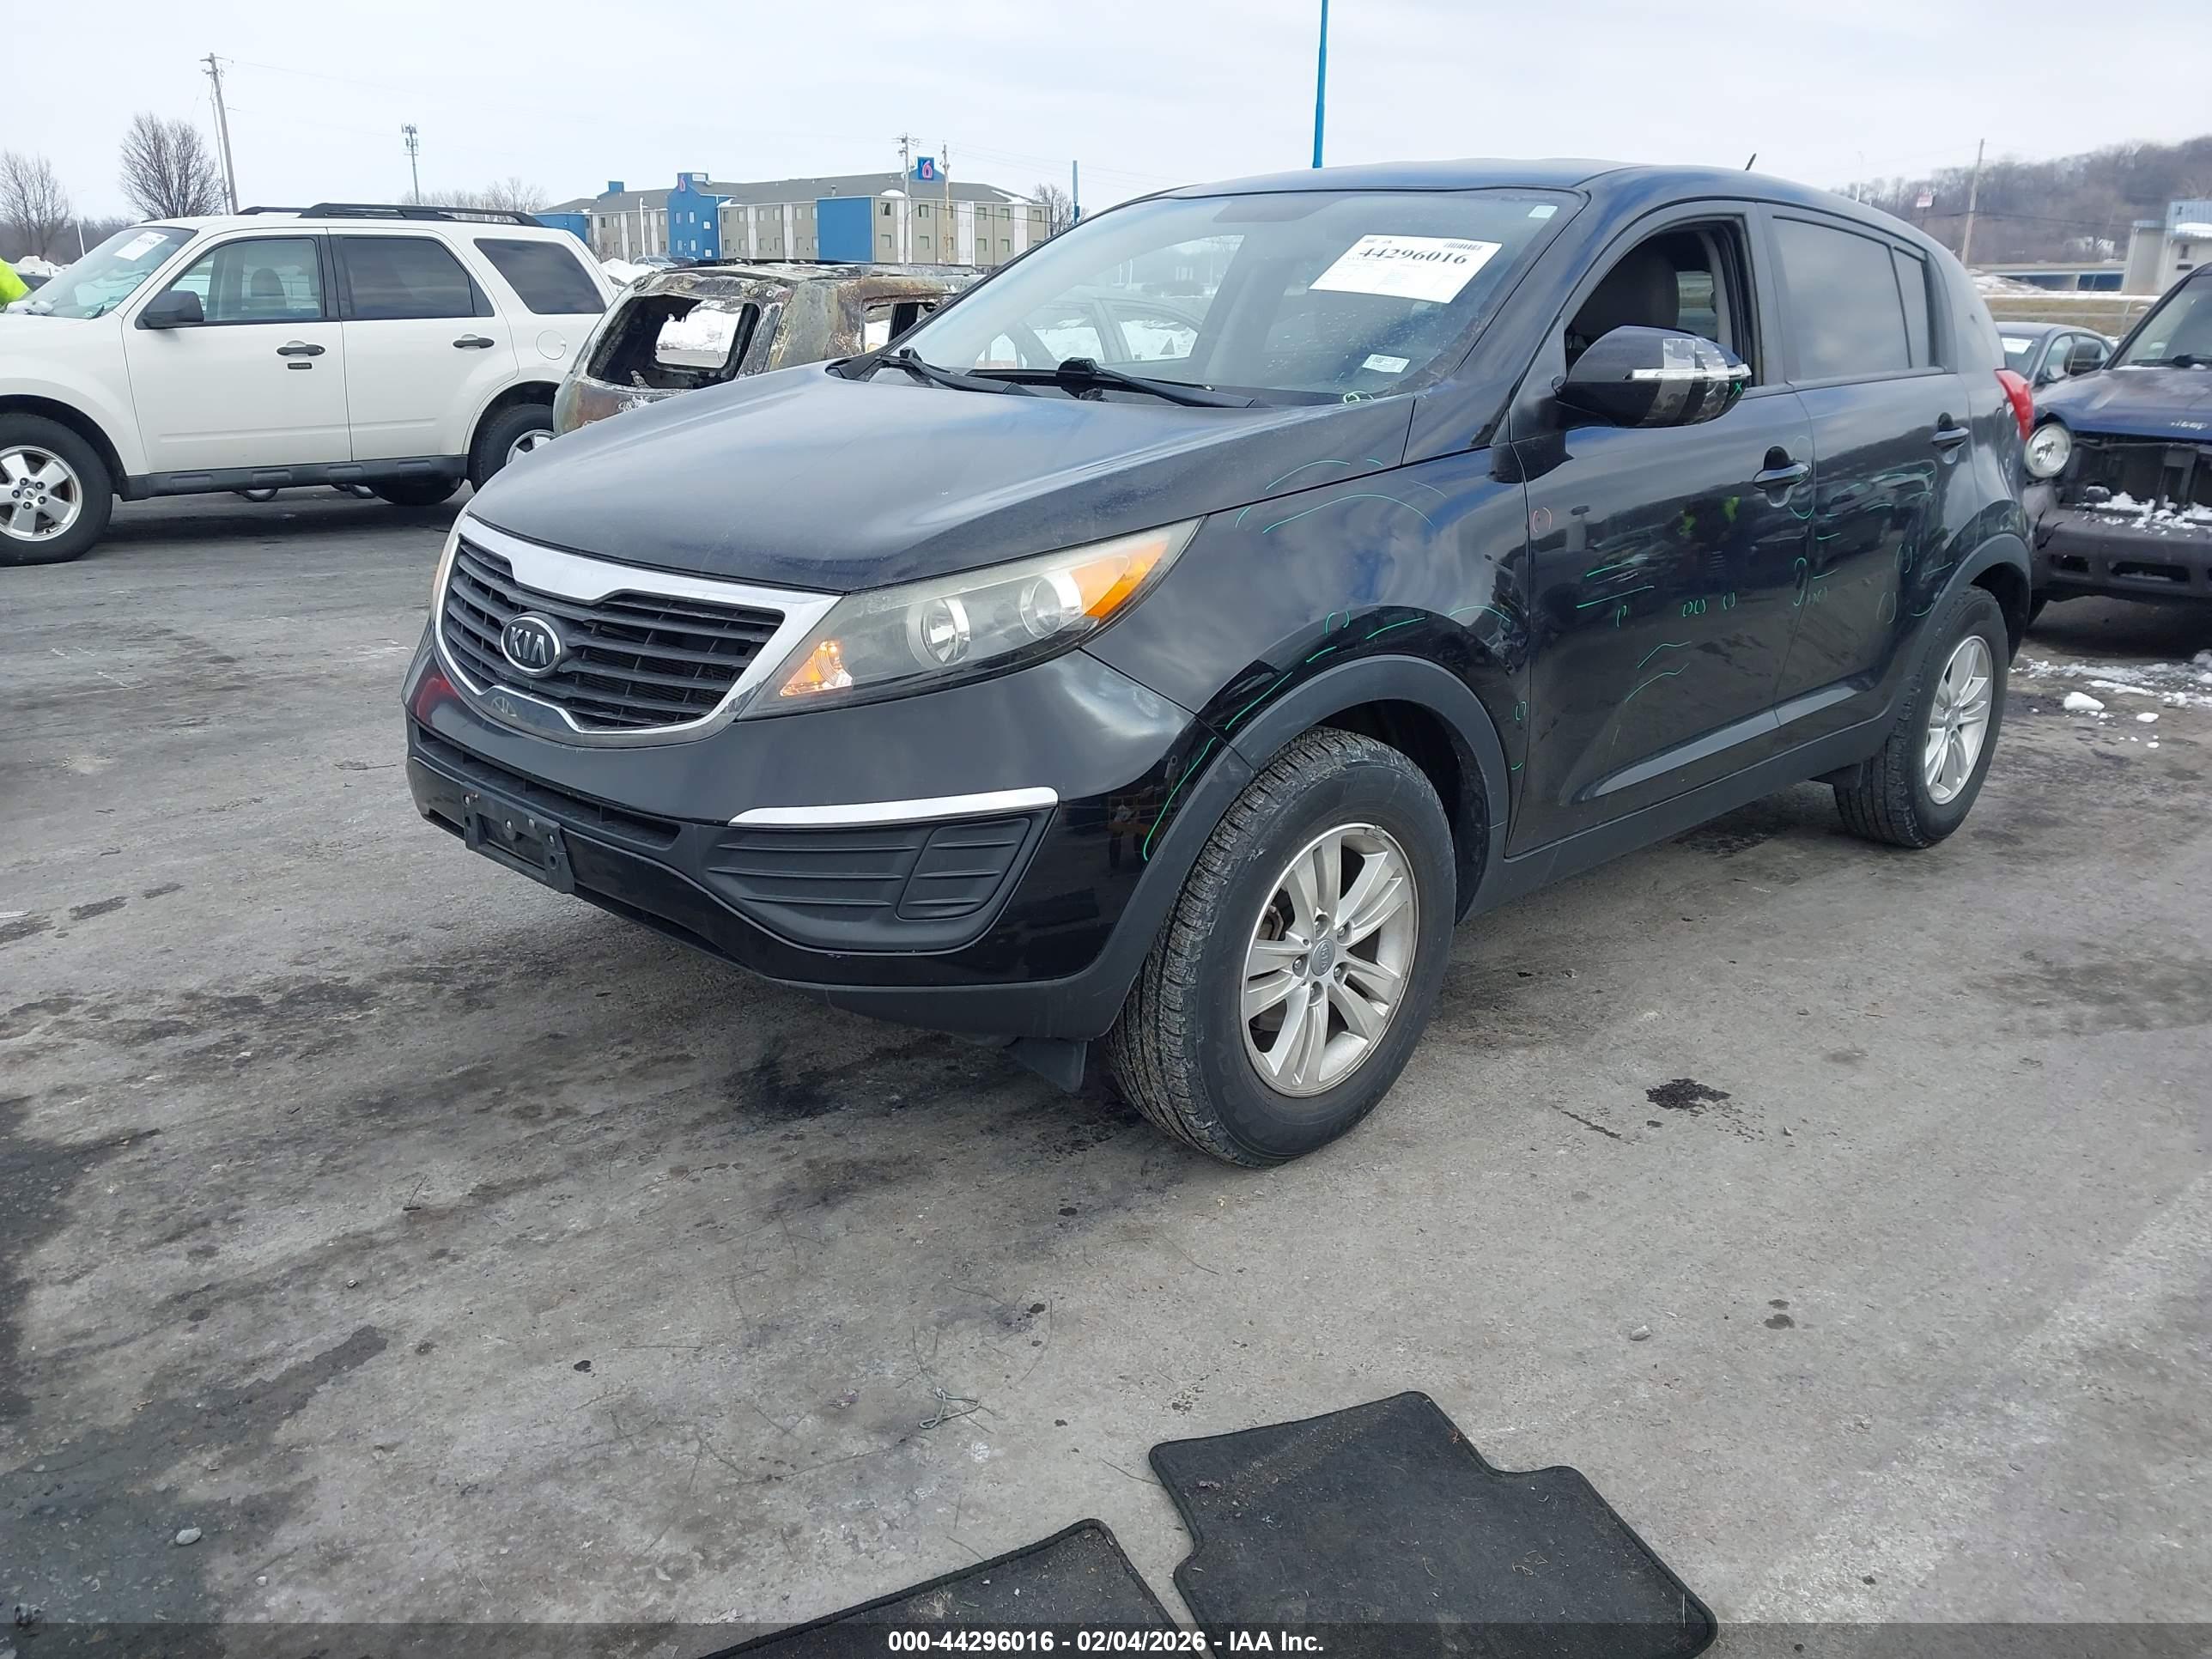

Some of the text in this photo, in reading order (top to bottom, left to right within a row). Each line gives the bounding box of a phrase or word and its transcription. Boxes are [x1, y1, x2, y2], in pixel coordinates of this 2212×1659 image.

[922, 160, 933, 179] 6
[1358, 247, 1470, 264] 44296016
[508, 626, 547, 665] KIA
